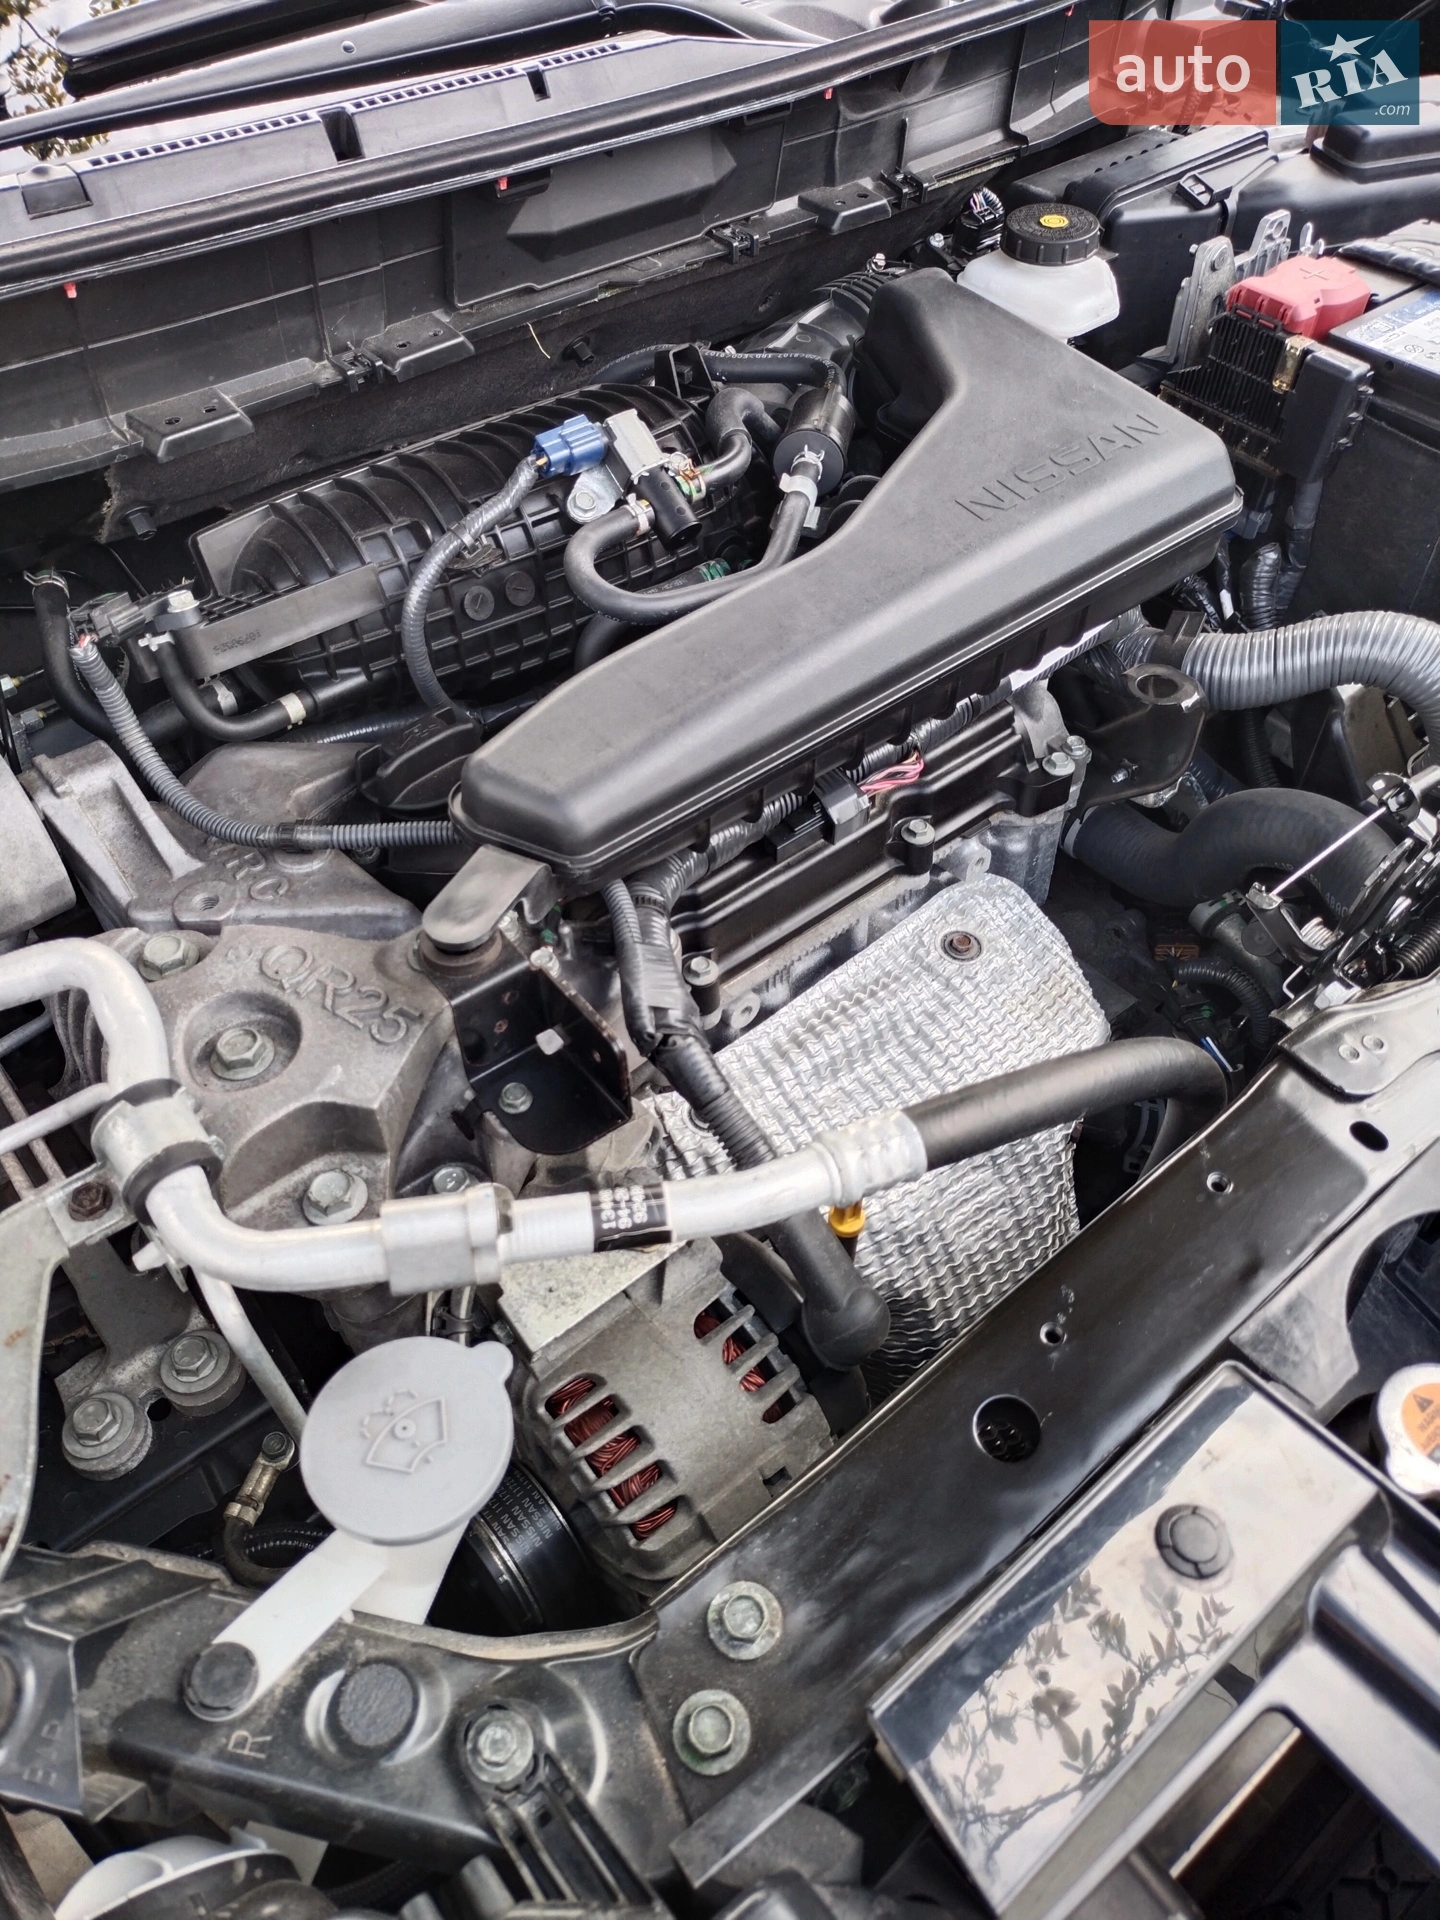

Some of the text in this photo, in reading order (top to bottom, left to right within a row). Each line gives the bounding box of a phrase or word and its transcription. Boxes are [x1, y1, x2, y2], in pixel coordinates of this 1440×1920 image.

[954, 413, 1164, 521] NISSAN
[259, 945, 424, 1045] QR25
[500, 1513, 533, 1556] NISSAN
[511, 1505, 543, 1548] NISSAN
[522, 1497, 554, 1540] NISSAN
[227, 1730, 272, 1759] R
